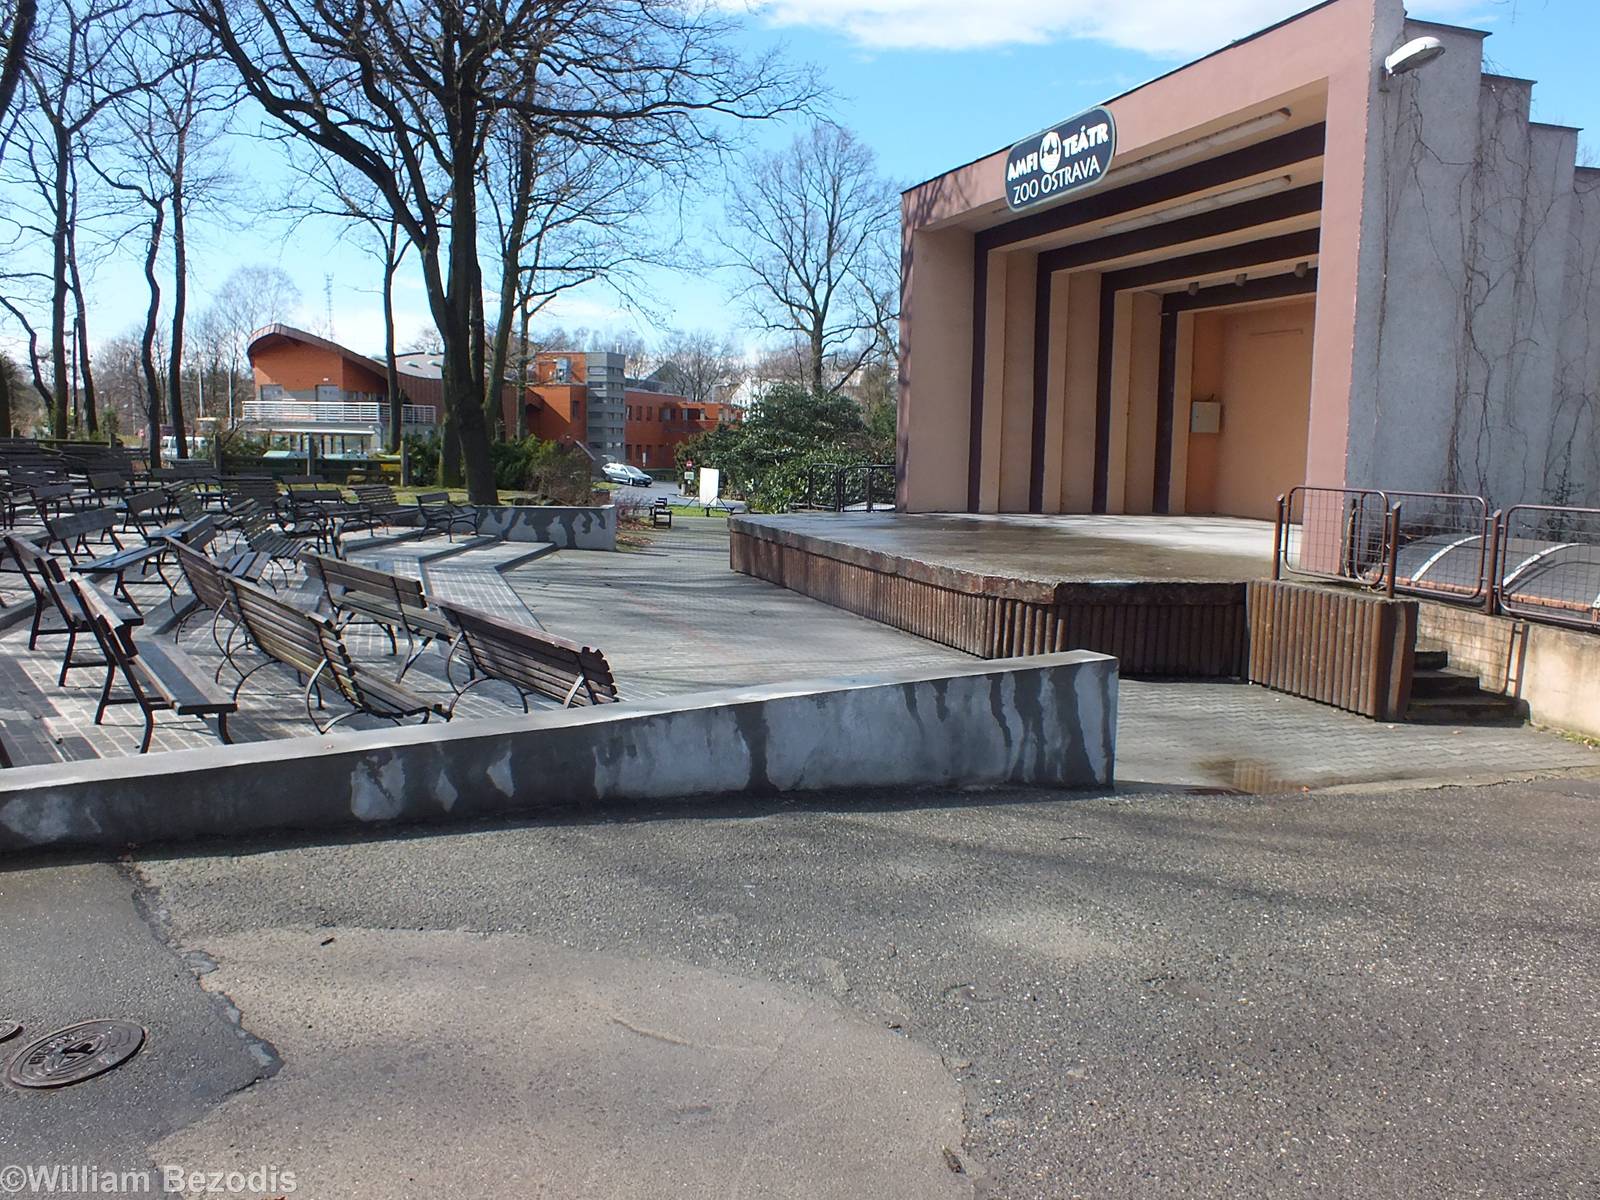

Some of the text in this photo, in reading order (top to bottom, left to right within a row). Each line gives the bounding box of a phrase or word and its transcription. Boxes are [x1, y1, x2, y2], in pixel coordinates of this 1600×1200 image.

[1007, 122, 1109, 181] AMFI TEÁTR
[1013, 154, 1101, 205] ZOO OSTRAVA
